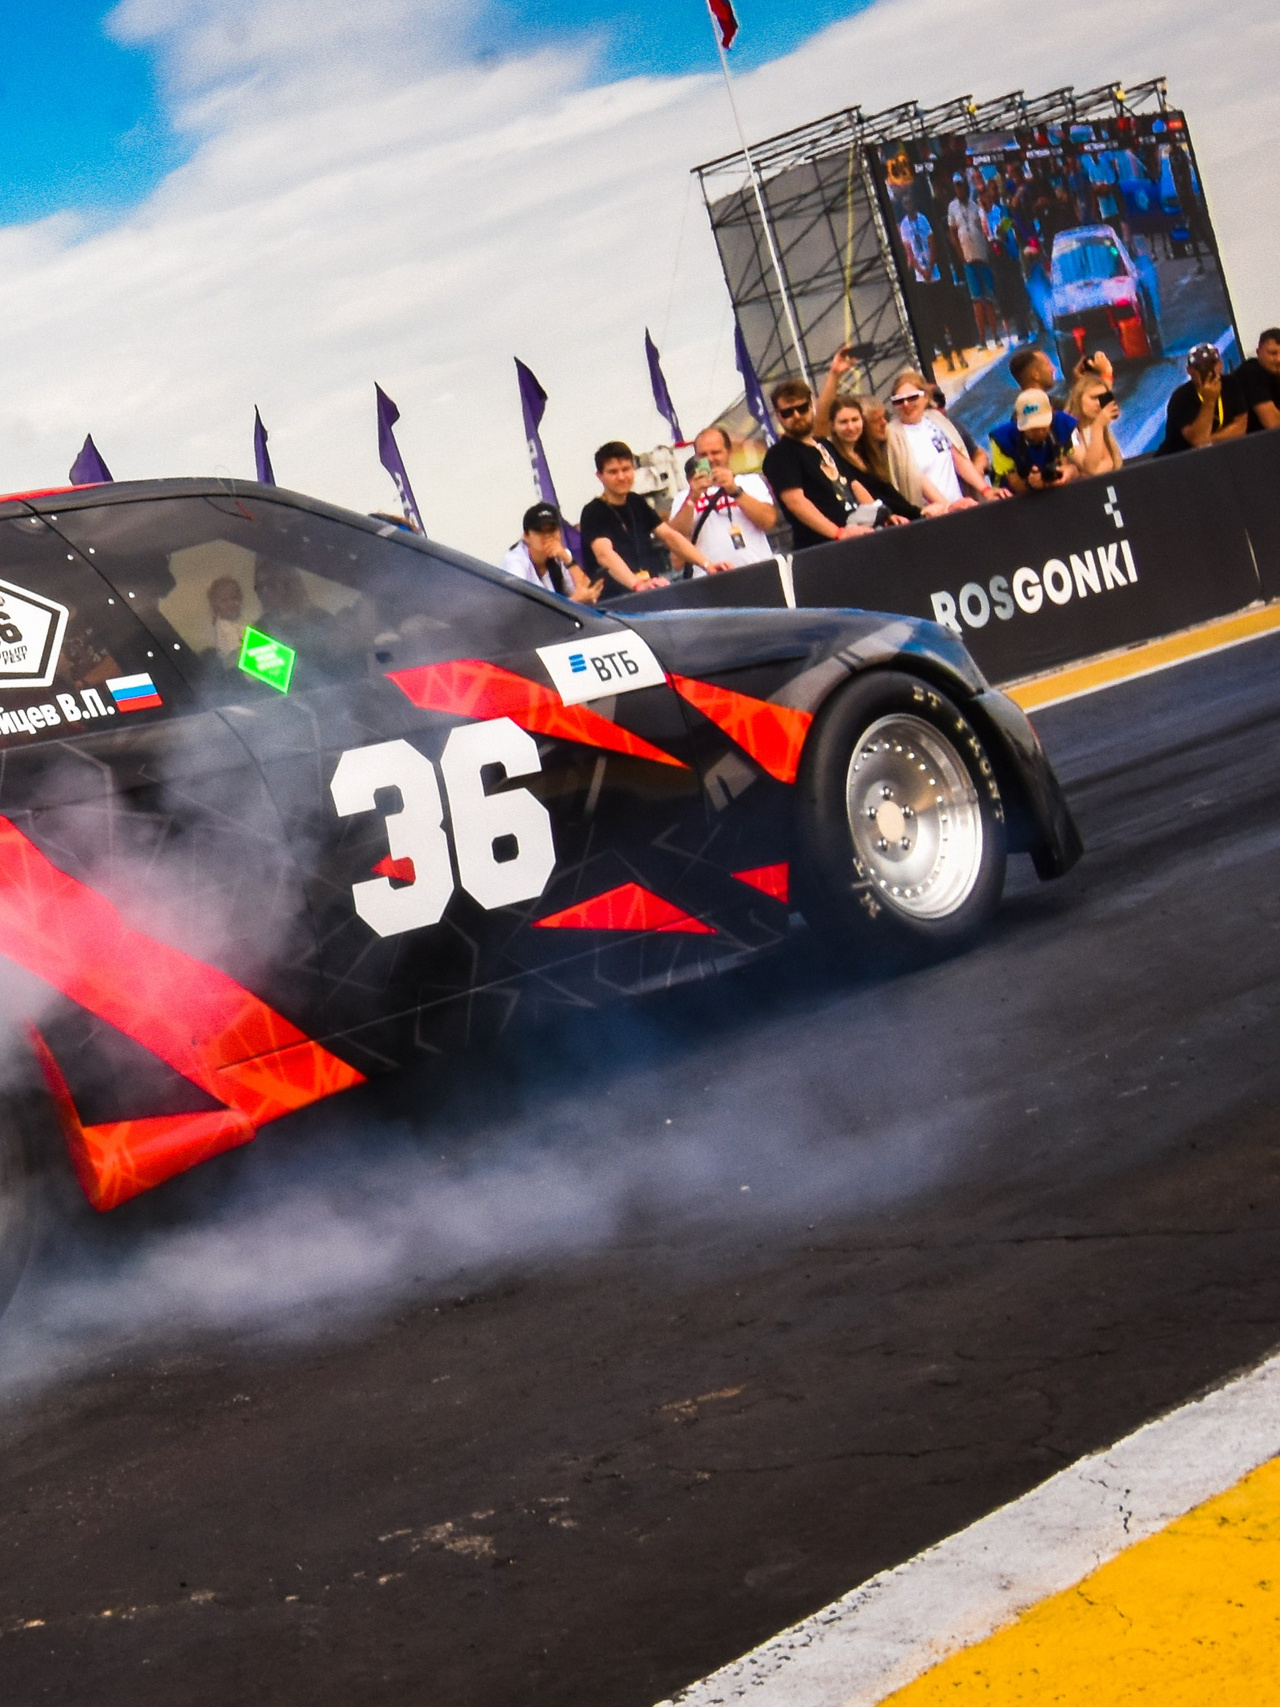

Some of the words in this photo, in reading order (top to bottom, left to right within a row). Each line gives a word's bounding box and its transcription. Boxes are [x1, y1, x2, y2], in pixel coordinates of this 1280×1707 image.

[930, 539, 1138, 636] ROSGONKI
[590, 650, 639, 682] ВТБ
[55, 688, 116, 722] В.П.
[330, 717, 556, 938] 36
